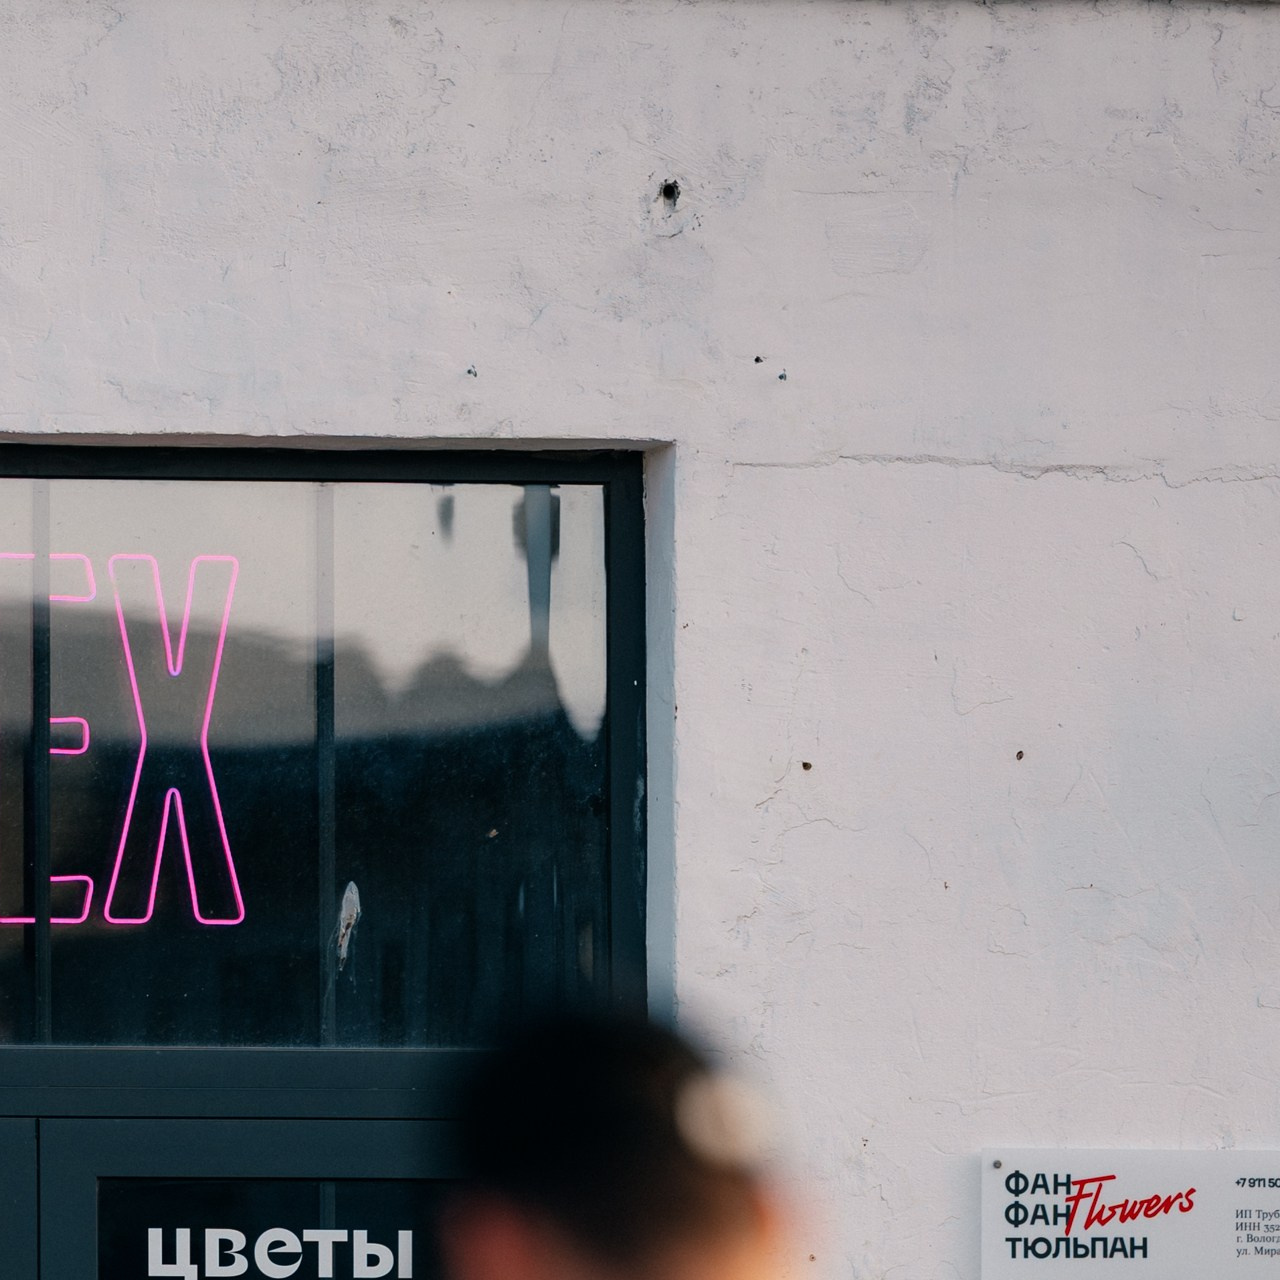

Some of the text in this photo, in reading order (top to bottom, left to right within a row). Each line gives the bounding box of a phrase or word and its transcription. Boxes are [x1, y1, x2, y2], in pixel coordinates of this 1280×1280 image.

[1005, 1170, 1071, 1197] ФАН
[1235, 1178, 1247, 1188] +7
[1248, 1178, 1266, 1188] 911
[1064, 1174, 1197, 1237] Flowers
[1004, 1201, 1071, 1228] ФАН
[1235, 1209, 1252, 1219] ИП
[1235, 1222, 1260, 1231] ИНН
[1005, 1237, 1148, 1259] ТЮЛЬПАН
[1236, 1248, 1251, 1258] ул.
